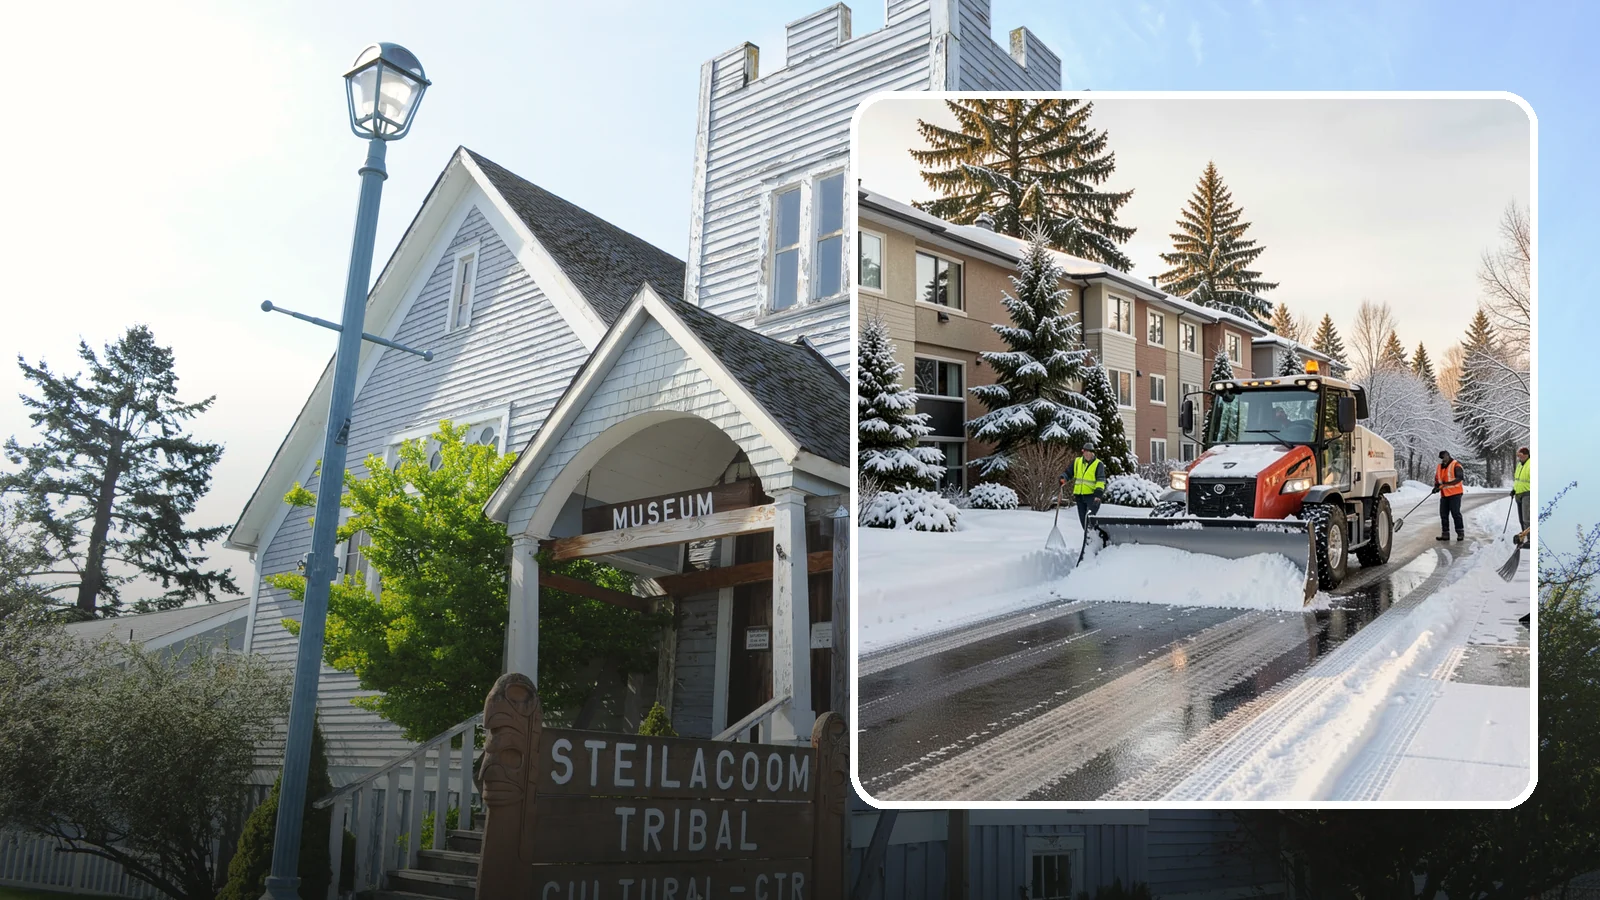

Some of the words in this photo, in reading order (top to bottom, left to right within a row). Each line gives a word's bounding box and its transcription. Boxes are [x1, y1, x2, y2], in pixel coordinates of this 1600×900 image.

[613, 492, 714, 530] MUSEUM
[551, 739, 809, 792] STEILACOOM
[615, 807, 757, 851] TRIBAL
